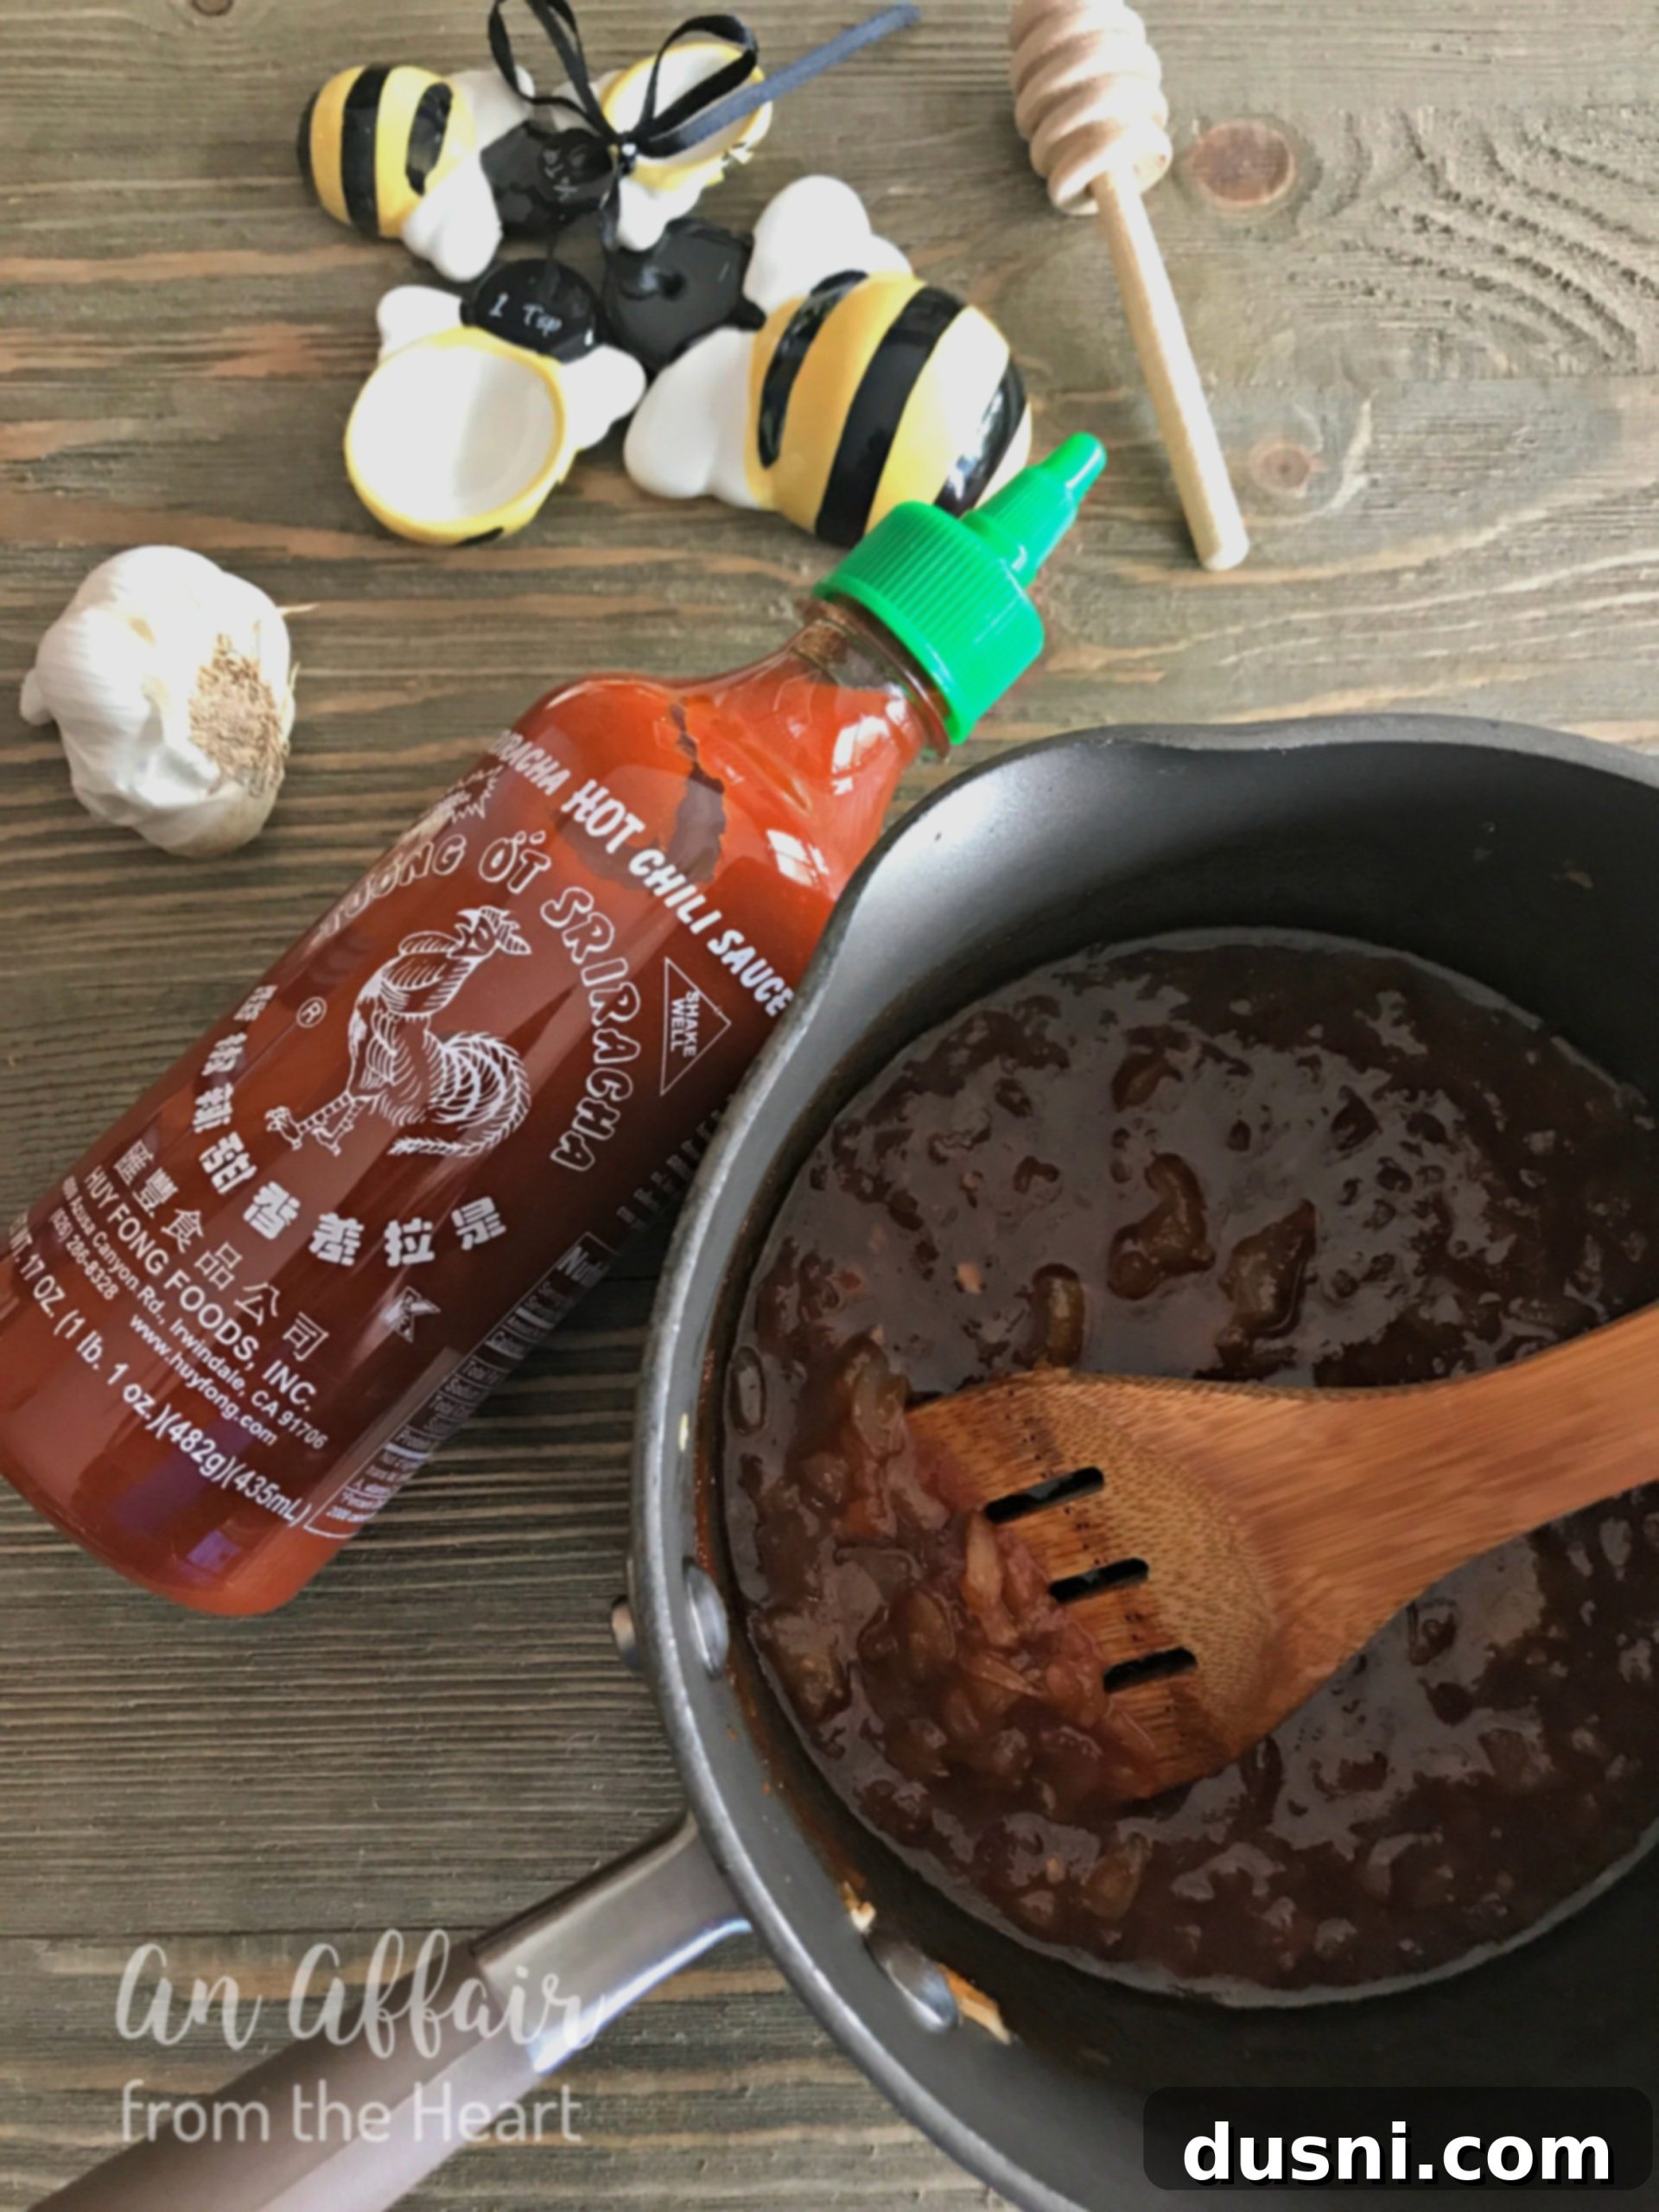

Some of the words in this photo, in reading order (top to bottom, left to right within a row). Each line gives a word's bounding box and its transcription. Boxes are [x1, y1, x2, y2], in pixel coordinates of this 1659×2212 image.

[560, 778, 645, 855] HOT
[628, 846, 721, 937] CHILI
[707, 930, 795, 1018] SAUCE
[540, 886, 641, 1172] SRIRACHA
[670, 997, 685, 1052] WELL
[682, 990, 701, 1058] SHAKE
[20, 1254, 45, 1281] 17
[33, 1274, 67, 1319] OZ.
[54, 1308, 86, 1339] (1
[76, 1330, 103, 1370] lb.
[106, 1363, 130, 1385] 1
[123, 1382, 313, 1529] oz.)(482g)(435mL)
[84, 1165, 120, 1209] HUY
[106, 1202, 170, 1276] FONG
[163, 1268, 259, 1372] FOODS,
[261, 1359, 316, 1413] INC.
[92, 1230, 139, 1291] Canyon
[137, 1285, 165, 1325] Rd.,
[169, 1318, 246, 1397] Irwindale,
[251, 1389, 279, 1418] CA
[277, 1410, 328, 1450] 91706
[130, 1313, 278, 1447] www.huyfong.com
